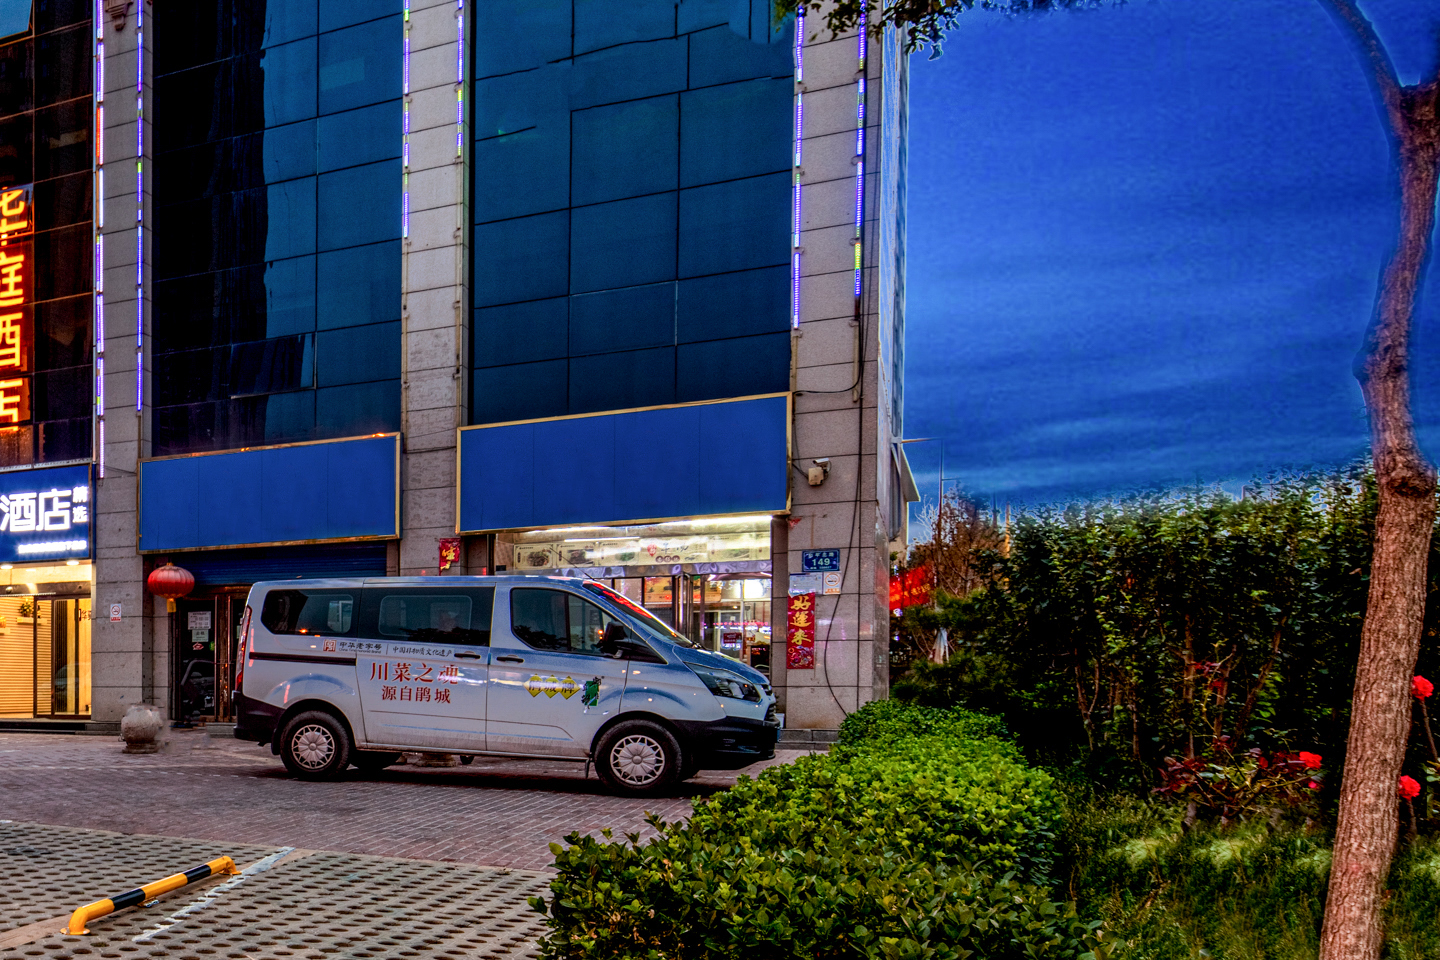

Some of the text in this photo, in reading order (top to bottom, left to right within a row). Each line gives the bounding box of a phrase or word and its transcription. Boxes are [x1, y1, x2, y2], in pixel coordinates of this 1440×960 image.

[812, 557, 831, 566] 149
[339, 641, 382, 651] 中华老字号
[369, 662, 459, 685] 川菜之魂
[381, 685, 451, 704] 源自鹃城
